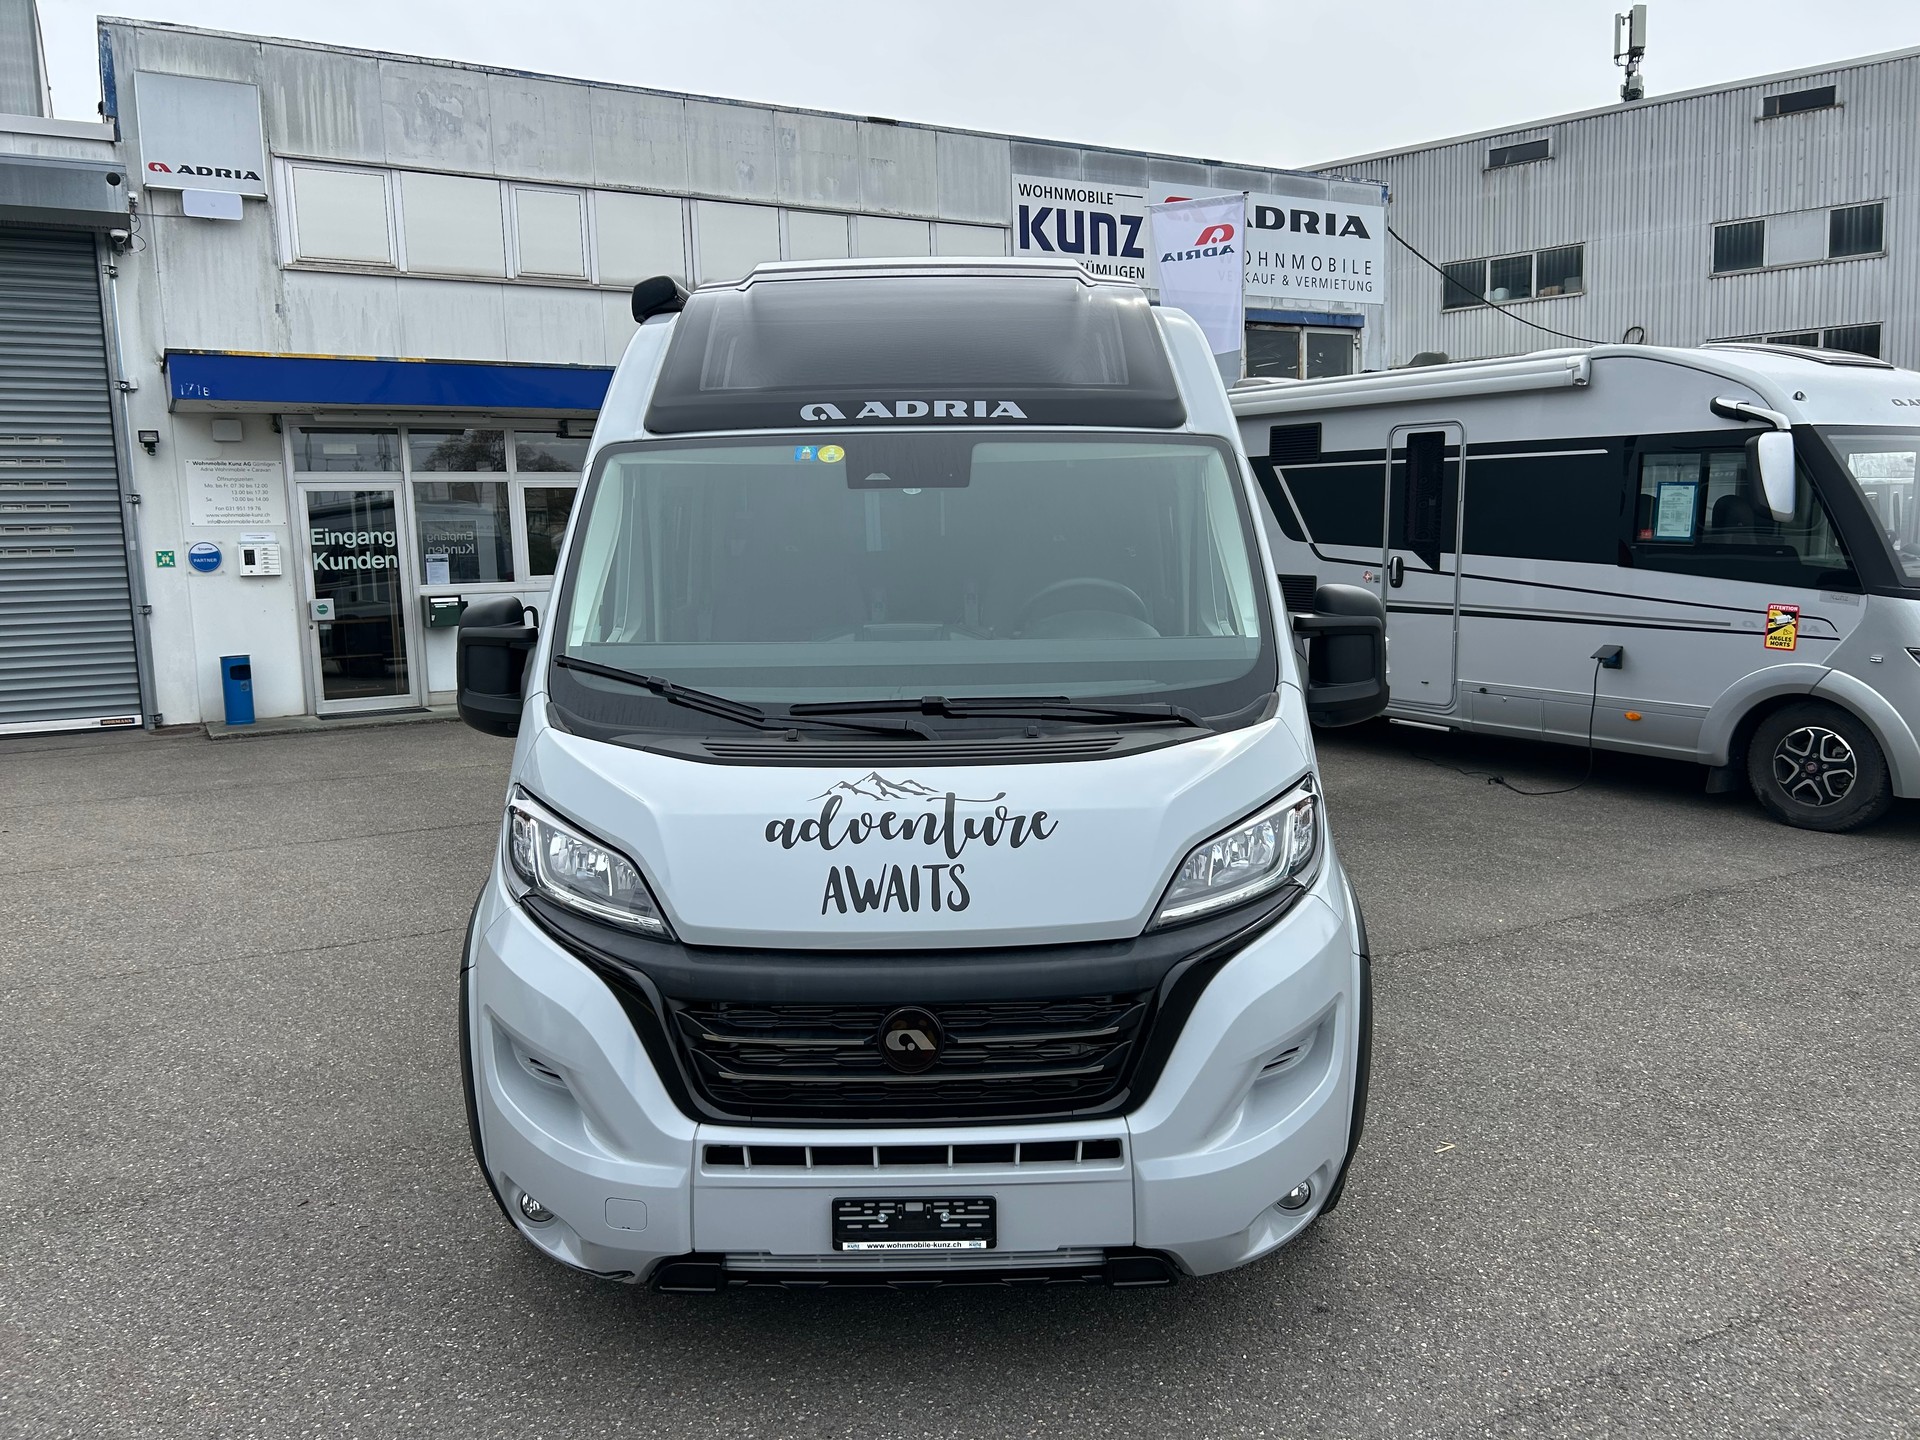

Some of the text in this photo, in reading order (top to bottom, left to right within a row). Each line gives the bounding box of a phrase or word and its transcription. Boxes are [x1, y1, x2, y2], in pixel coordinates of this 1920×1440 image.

[176, 164, 261, 181] ADRIA
[1018, 183, 1114, 205] WOHNMOBILE
[1246, 205, 1371, 240] DRIA
[1281, 274, 1290, 286] &
[1295, 275, 1373, 293] VERMIETUNG
[855, 400, 1028, 419] ADRIA
[310, 528, 396, 548] Eingang
[313, 551, 398, 571] Kunden
[1769, 604, 1799, 612] ATTENTION
[1768, 635, 1792, 643] ANGLES
[765, 792, 1059, 860] adventure
[821, 863, 970, 915] AWAITS
[866, 1241, 962, 1249] www.wohnmobile-kunz.ch
